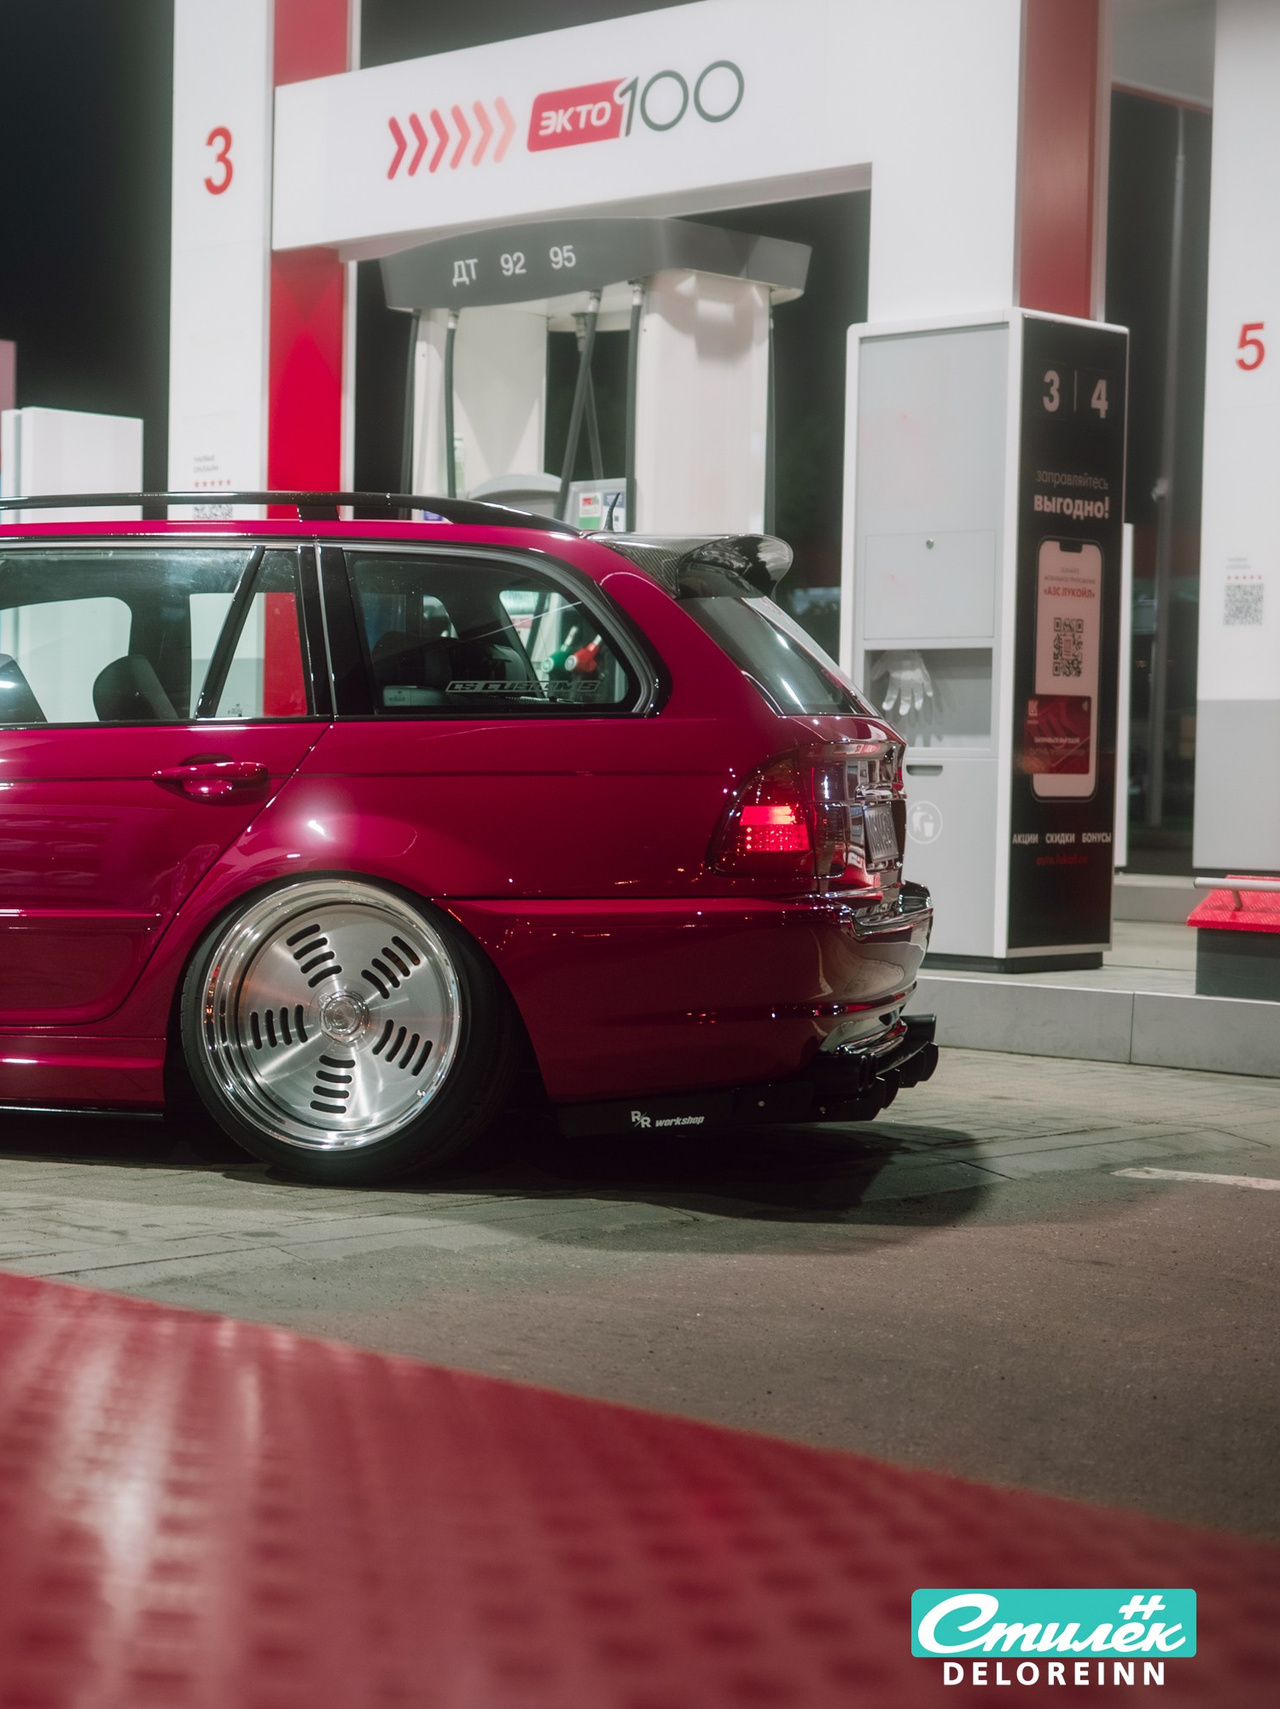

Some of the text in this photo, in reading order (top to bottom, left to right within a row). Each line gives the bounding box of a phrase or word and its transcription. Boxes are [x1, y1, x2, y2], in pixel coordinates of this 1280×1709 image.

[538, 60, 745, 137] ЭКТО 100
[204, 126, 233, 195] 3
[452, 245, 576, 287] ДТ 92 95
[1236, 322, 1265, 371] 5
[1042, 370, 1108, 419] 3 4
[1012, 832, 1112, 845] АКЦИИ СКИДКИ БОНУСЫ
[655, 1116, 705, 1127] workshop
